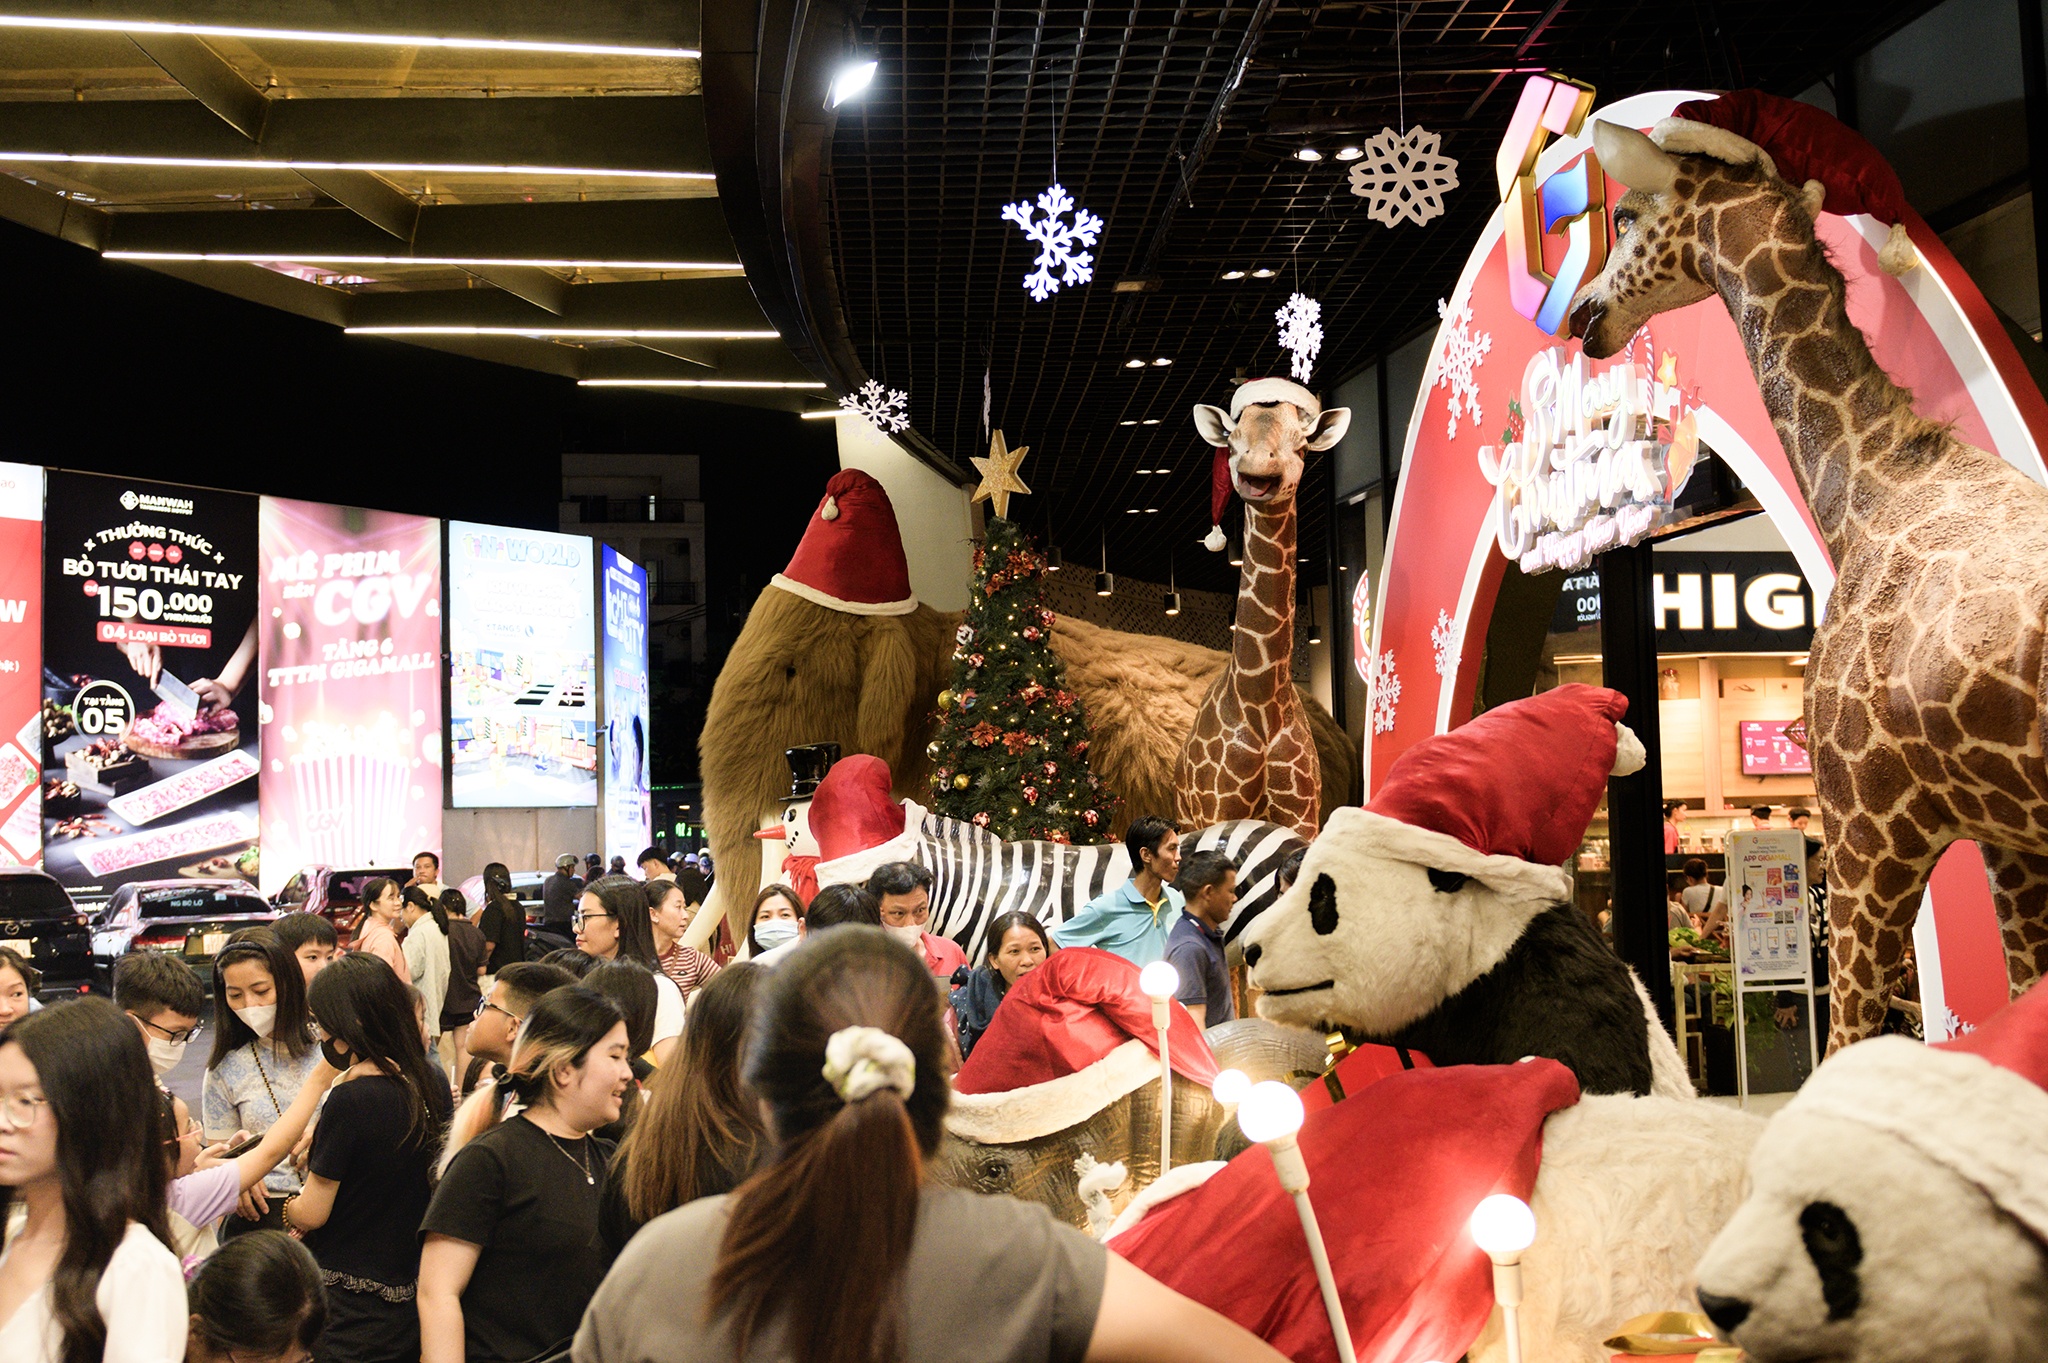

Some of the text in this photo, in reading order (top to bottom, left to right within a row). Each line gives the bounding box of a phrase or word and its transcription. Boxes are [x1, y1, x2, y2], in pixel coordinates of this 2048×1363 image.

[139, 494, 194, 510] MANWAH
[96, 520, 166, 543] THƯỞNG
[168, 528, 213, 555] THỨC
[1615, 503, 1653, 546] Year
[322, 549, 400, 578] PHIM
[505, 537, 581, 568] WORLD
[63, 553, 243, 590] BÒ TƯƠI THÁI TAY
[96, 585, 213, 621] 150.000
[313, 572, 432, 627] CGV
[102, 624, 206, 644] 04 LOẠI BÒ TƯƠI
[380, 637, 394, 655] 6
[330, 652, 435, 680] GIGAMALL
[82, 708, 126, 734] 05
[306, 811, 344, 833] CGV
[1743, 853, 1793, 862] APP GIGAMALL
